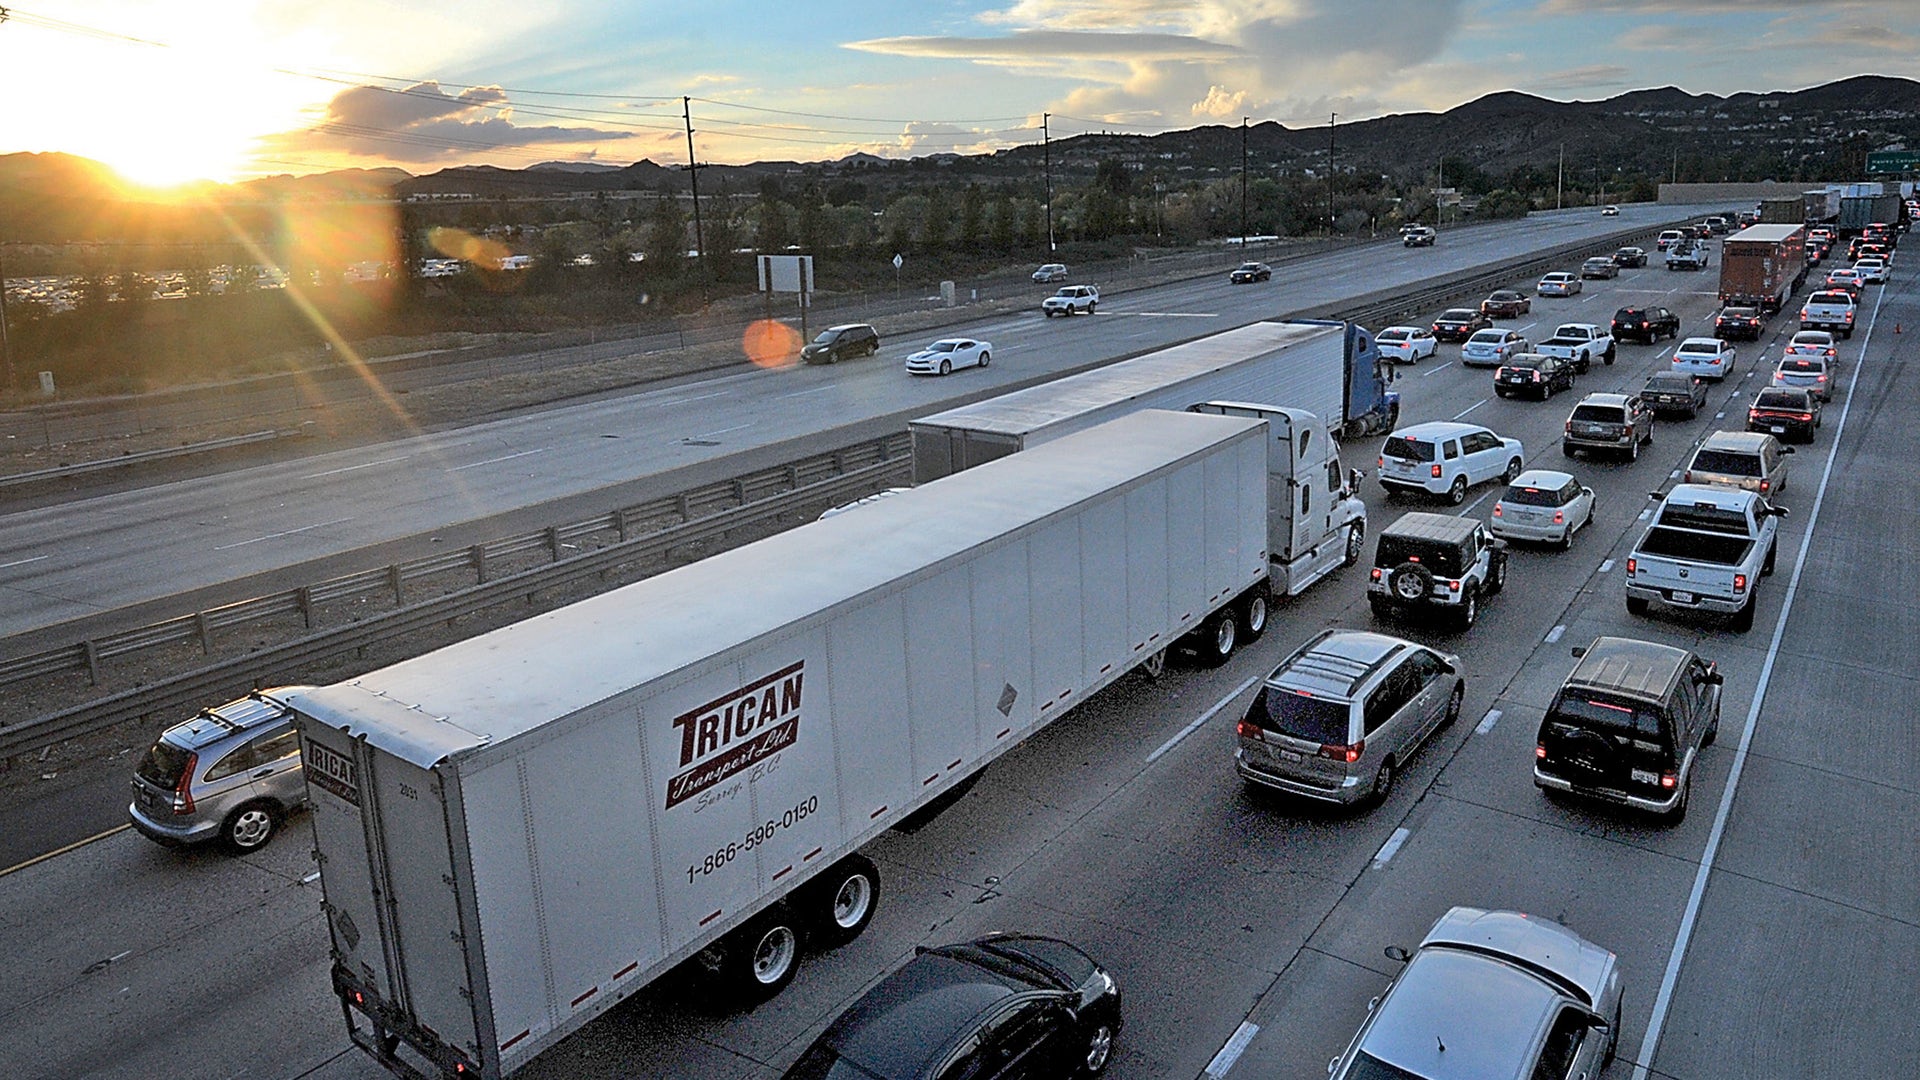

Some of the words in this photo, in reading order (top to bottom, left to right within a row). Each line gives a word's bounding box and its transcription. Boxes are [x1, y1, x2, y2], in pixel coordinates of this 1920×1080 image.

[672, 659, 805, 768] TRICAN
[673, 743, 756, 799] Transport
[755, 722, 793, 757] Ltd.
[686, 795, 818, 884] 1-866-596-0150
